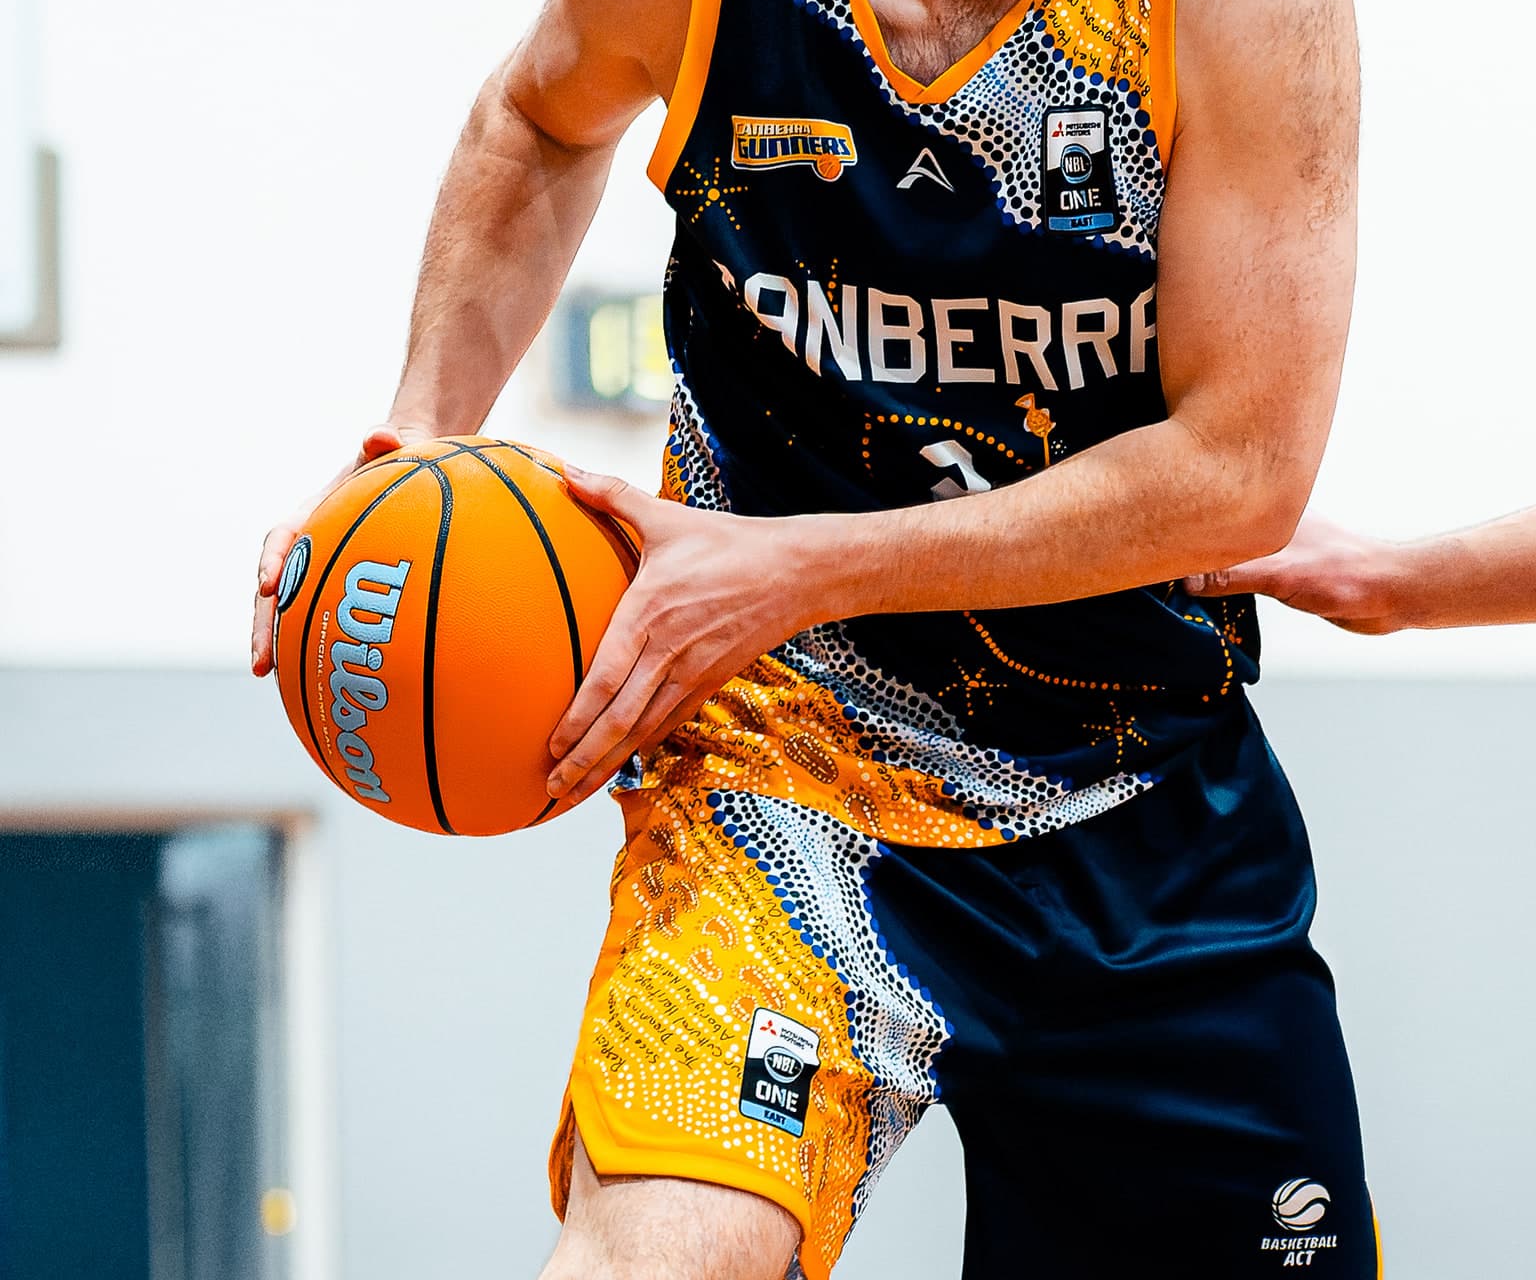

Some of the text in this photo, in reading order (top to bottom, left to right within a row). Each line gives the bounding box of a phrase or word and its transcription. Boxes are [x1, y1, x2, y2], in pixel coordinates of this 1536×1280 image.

[736, 122, 812, 135] CANBERRA
[737, 136, 851, 159] GUNNERS
[1064, 156, 1087, 174] NBL
[1060, 187, 1102, 211] ONE
[713, 261, 1156, 391] ANBERR
[329, 559, 412, 803] Wilson
[772, 1056, 795, 1075] NBL
[755, 1079, 799, 1112] ONE
[1261, 1235, 1338, 1251] BASKETBALL
[1283, 1250, 1316, 1267] ACT
